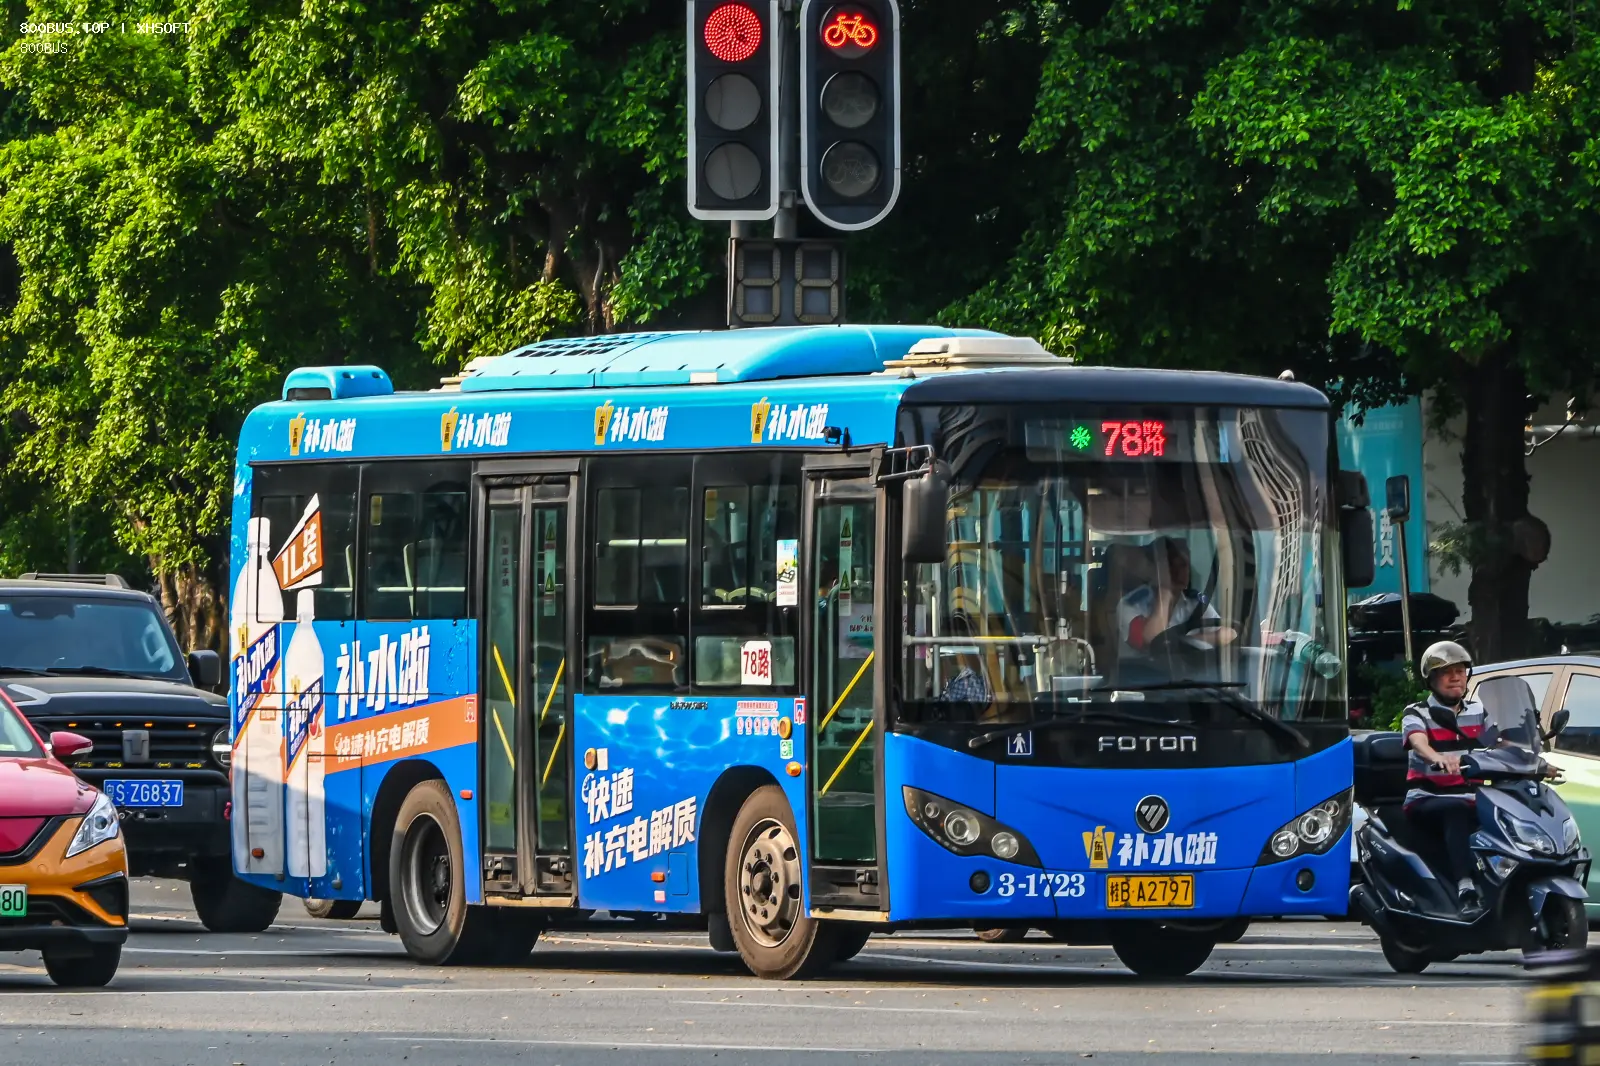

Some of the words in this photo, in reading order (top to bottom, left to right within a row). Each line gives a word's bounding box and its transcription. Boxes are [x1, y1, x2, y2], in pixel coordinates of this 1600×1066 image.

[304, 418, 357, 453] 补水啦
[456, 412, 512, 448] 补水啦
[611, 406, 668, 443] 补水啦
[768, 403, 829, 441] 补水啦
[1101, 421, 1166, 456] 78路
[236, 630, 276, 706] 补水啦
[335, 624, 431, 719] 补水啦
[743, 648, 770, 678] 78路
[289, 681, 321, 741] 补水啦
[335, 717, 430, 763] 快速补充电解质
[1098, 736, 1197, 751] FOTON
[587, 767, 634, 824] 快速
[583, 796, 697, 879] 补充电解质
[1117, 832, 1218, 866] 补水啦
[998, 873, 1085, 897] 3-1723
[1110, 880, 1191, 903] 桂B·A2797
